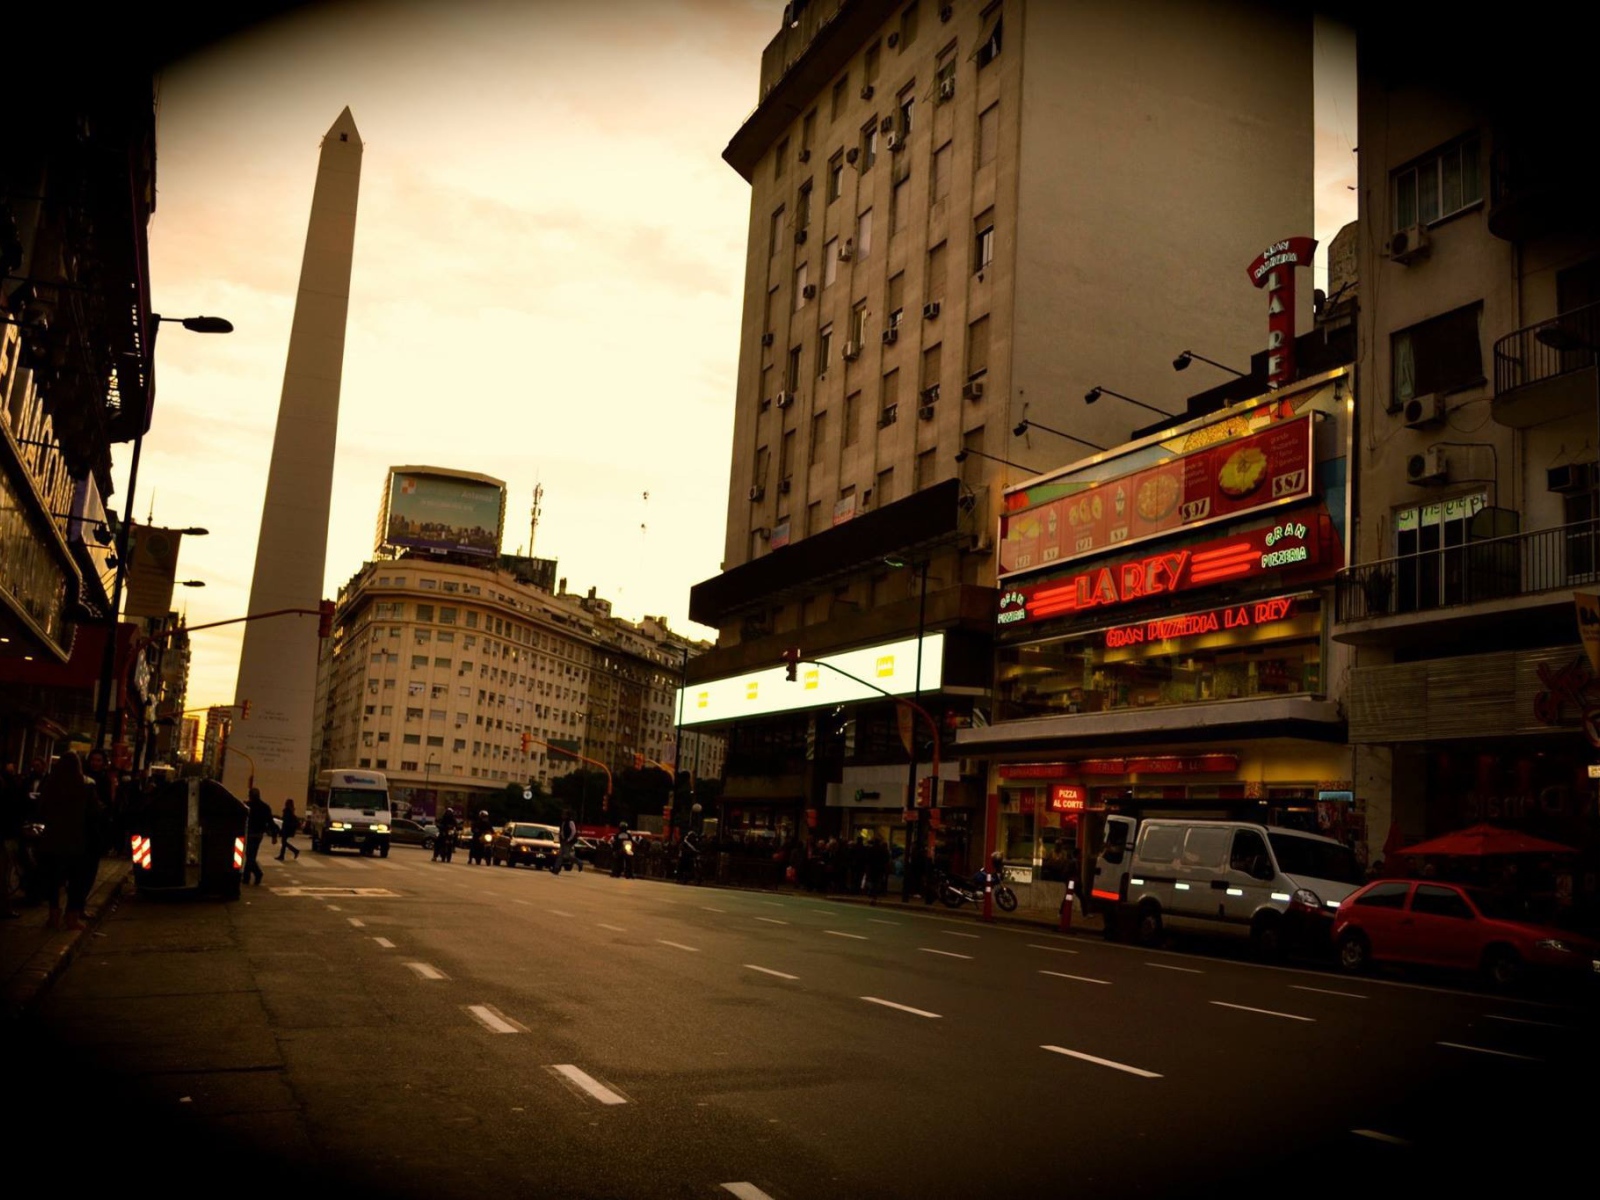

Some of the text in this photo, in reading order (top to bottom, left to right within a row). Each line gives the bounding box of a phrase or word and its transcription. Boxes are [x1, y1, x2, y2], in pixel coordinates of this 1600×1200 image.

[1265, 523, 1306, 546] GRAN
[1261, 546, 1307, 568] PIZZERIA
[1074, 550, 1192, 609] LA REY
[1106, 599, 1292, 648] GRAN PIZZERIA LA REY
[1053, 800, 1084, 809] AL CORTE
[1059, 789, 1077, 799] PIZZA
